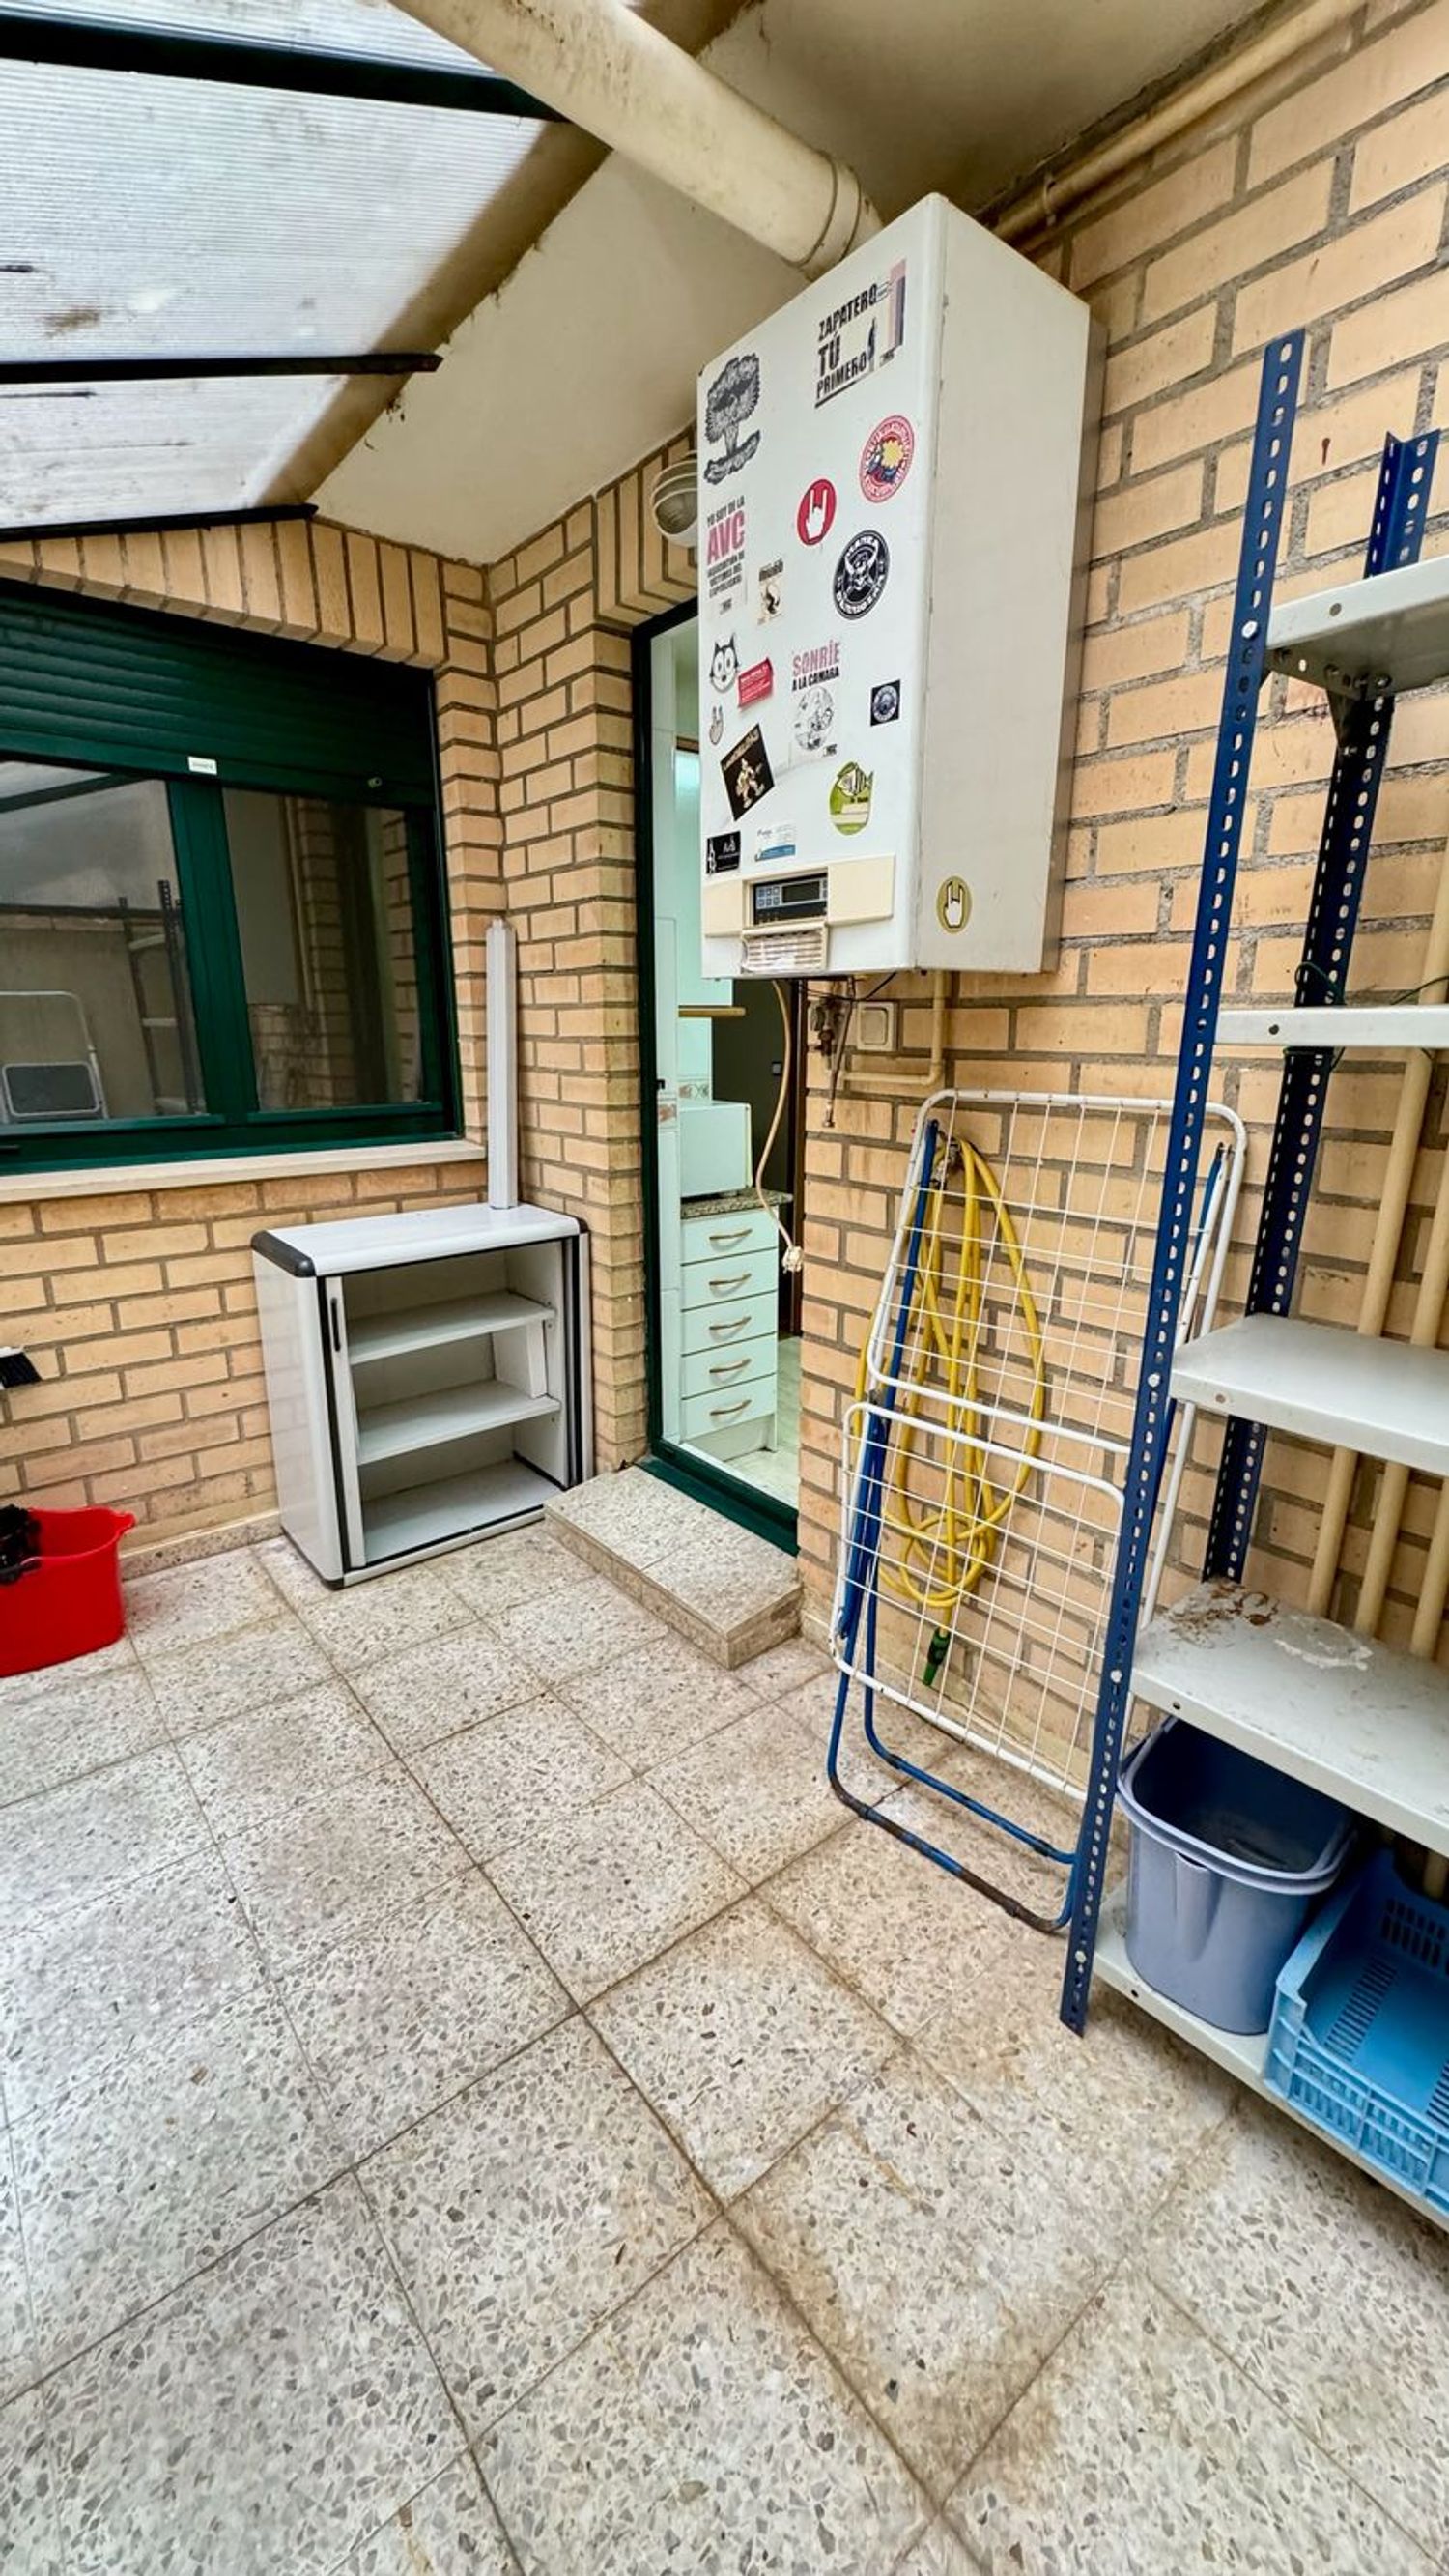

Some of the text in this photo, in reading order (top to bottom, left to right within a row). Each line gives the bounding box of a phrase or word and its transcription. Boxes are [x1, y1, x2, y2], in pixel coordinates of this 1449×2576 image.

[818, 282, 878, 342] ZAPATERO
[816, 351, 867, 400] PRIMERO
[817, 331, 840, 377] TÚ
[716, 504, 727, 523] SOY
[728, 499, 735, 515] DE
[737, 494, 745, 509] LA
[707, 510, 745, 567] AVC
[792, 639, 840, 676] SONRÍE
[792, 679, 798, 691] A
[798, 675, 807, 691] LA
